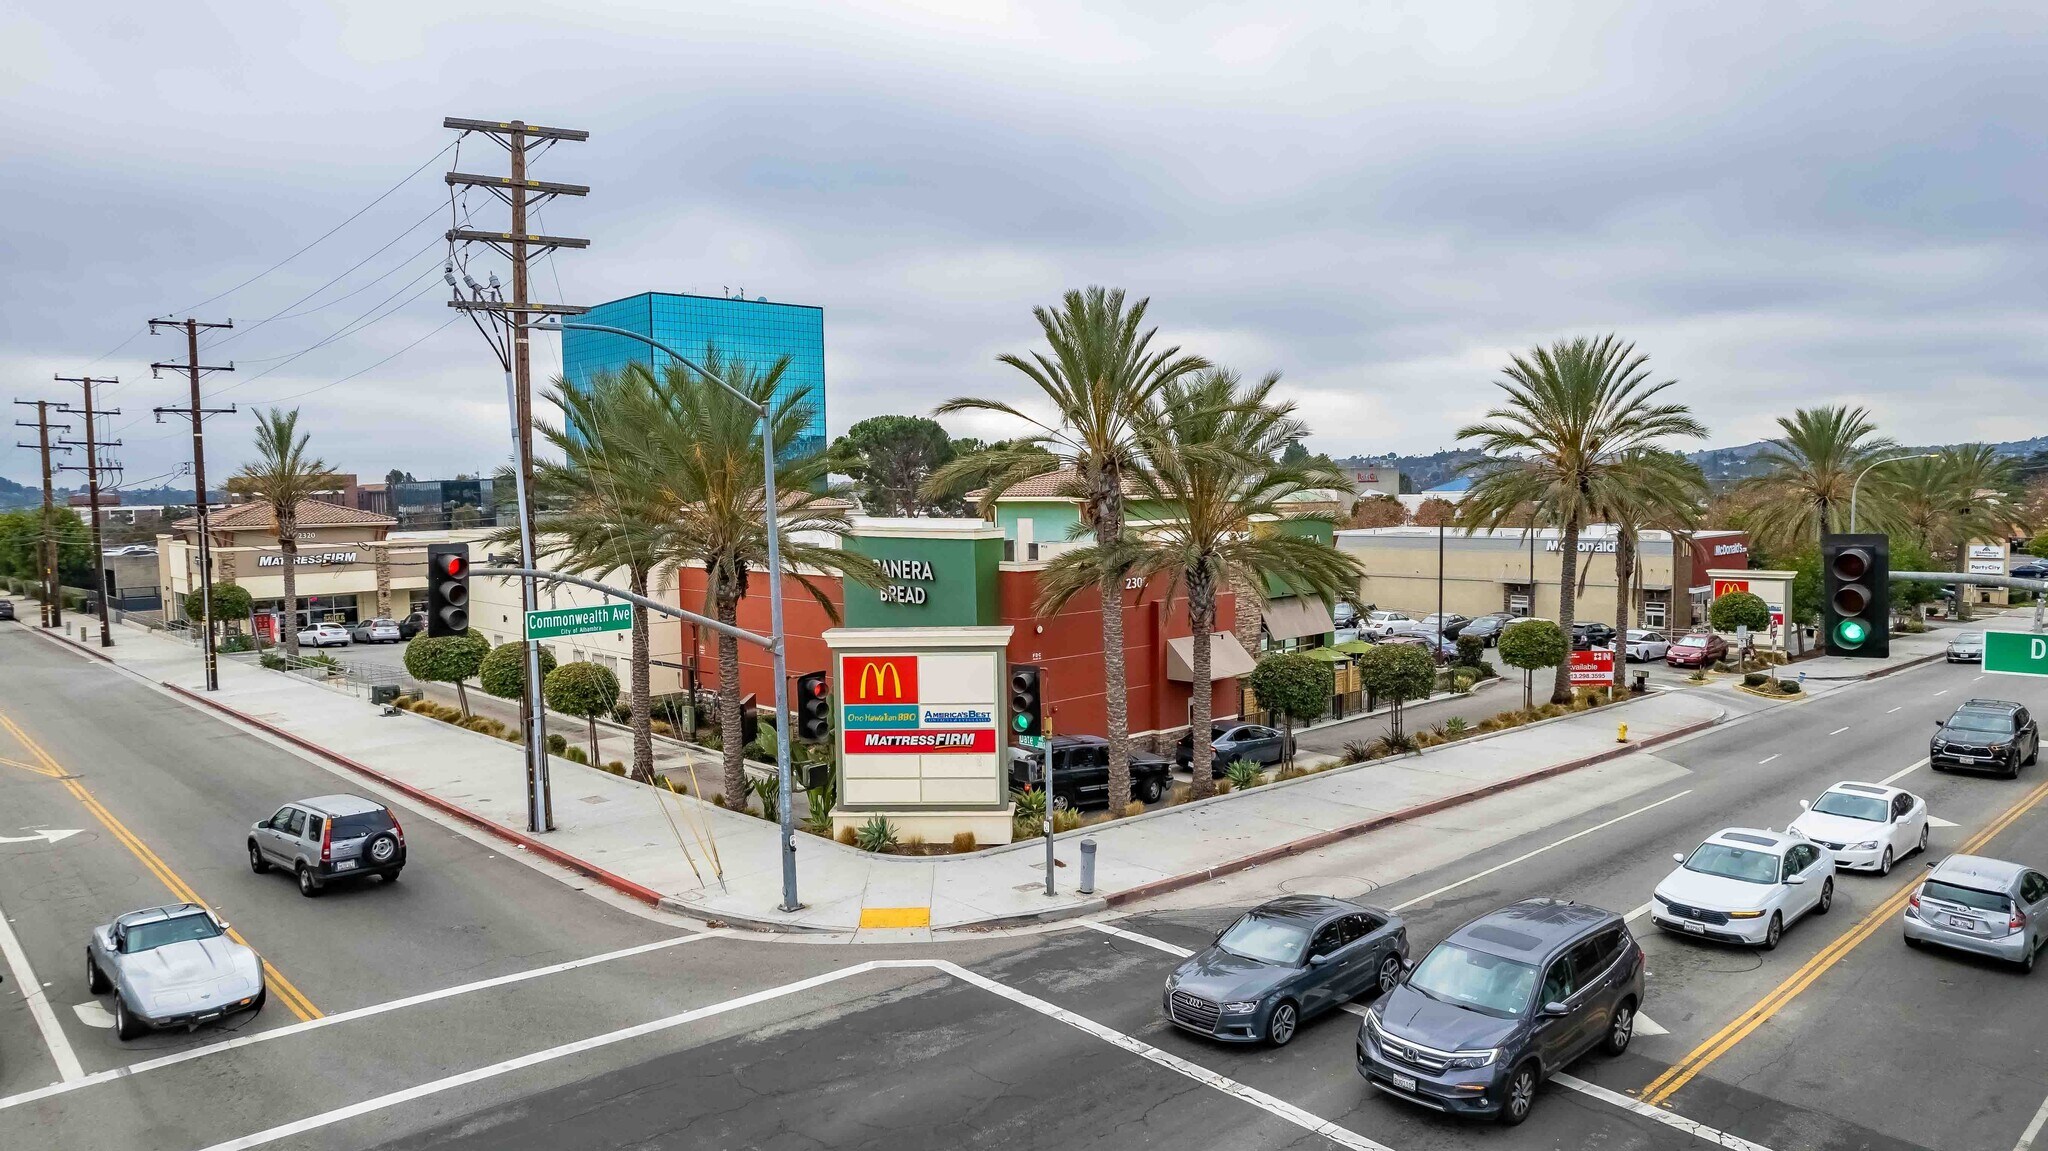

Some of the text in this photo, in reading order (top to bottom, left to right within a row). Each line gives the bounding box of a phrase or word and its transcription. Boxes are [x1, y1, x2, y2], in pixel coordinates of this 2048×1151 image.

[1546, 540, 1619, 552] Mconald'
[259, 552, 357, 566] MATRESSFIRM
[1125, 577, 1149, 589] 230
[880, 585, 926, 604] BREAD
[529, 607, 630, 629] Commonwealth Ave
[2030, 638, 2047, 660] D
